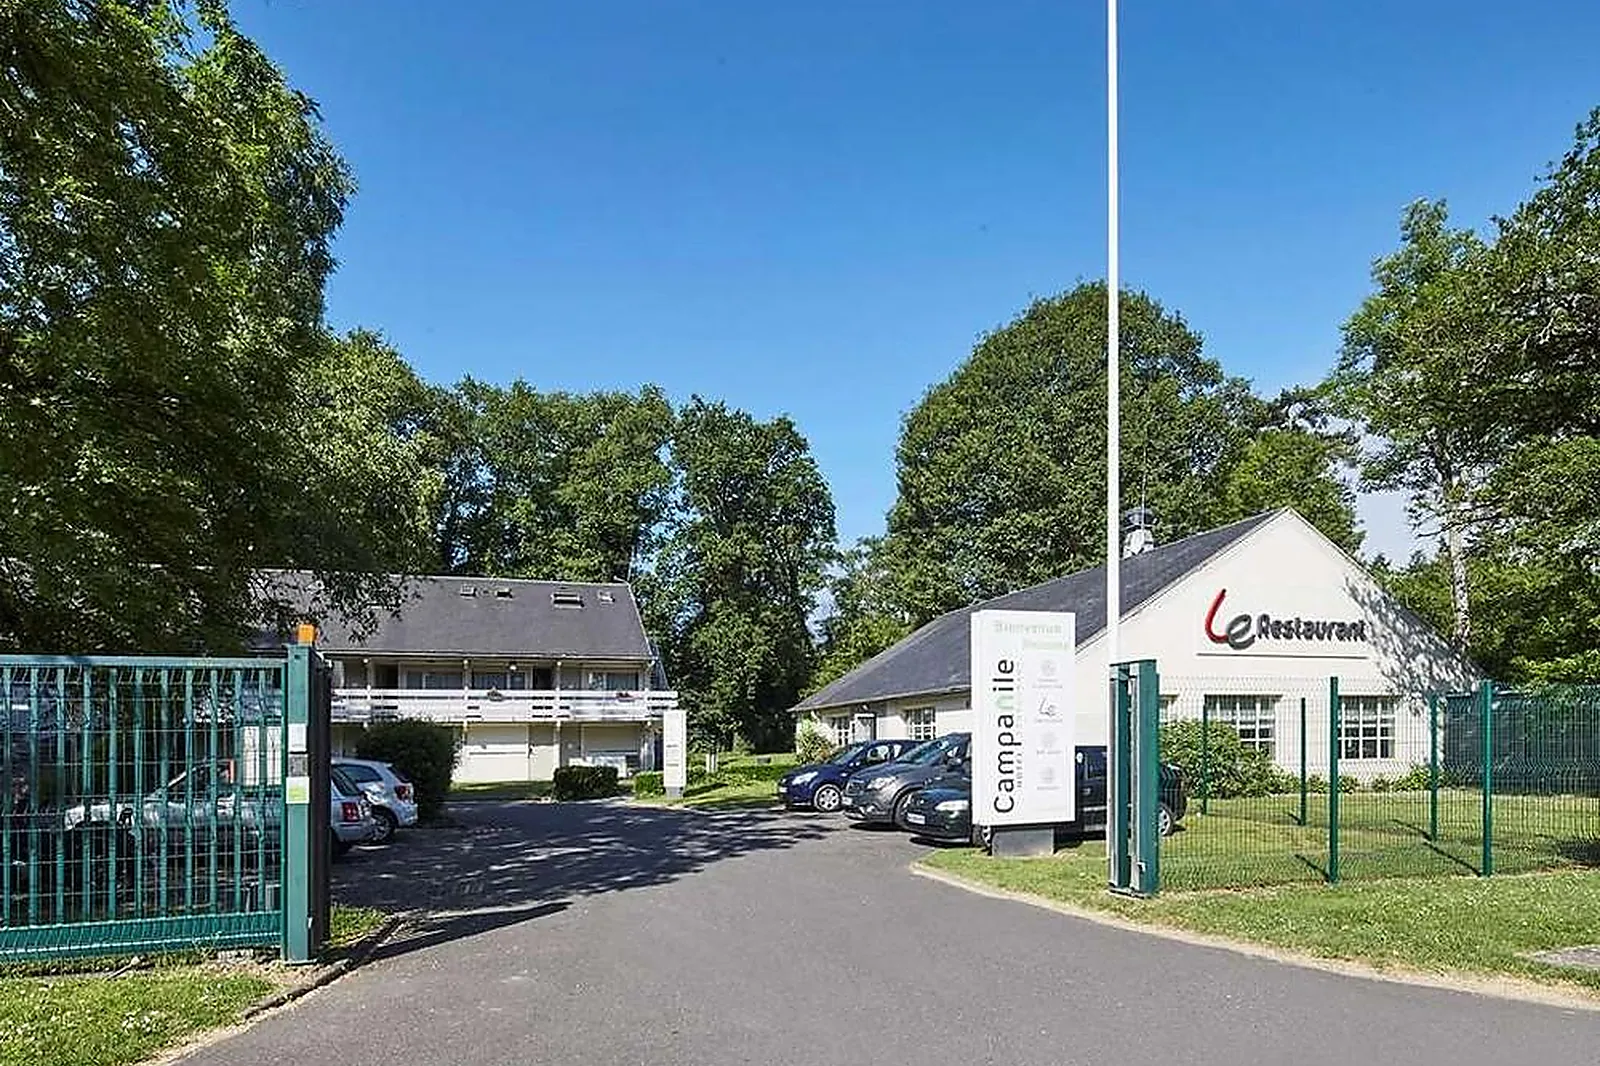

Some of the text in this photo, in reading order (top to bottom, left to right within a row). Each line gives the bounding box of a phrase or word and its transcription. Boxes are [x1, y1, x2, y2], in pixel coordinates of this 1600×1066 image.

[1205, 588, 1367, 650] Le Restaurant
[993, 659, 1022, 814] Campanile
